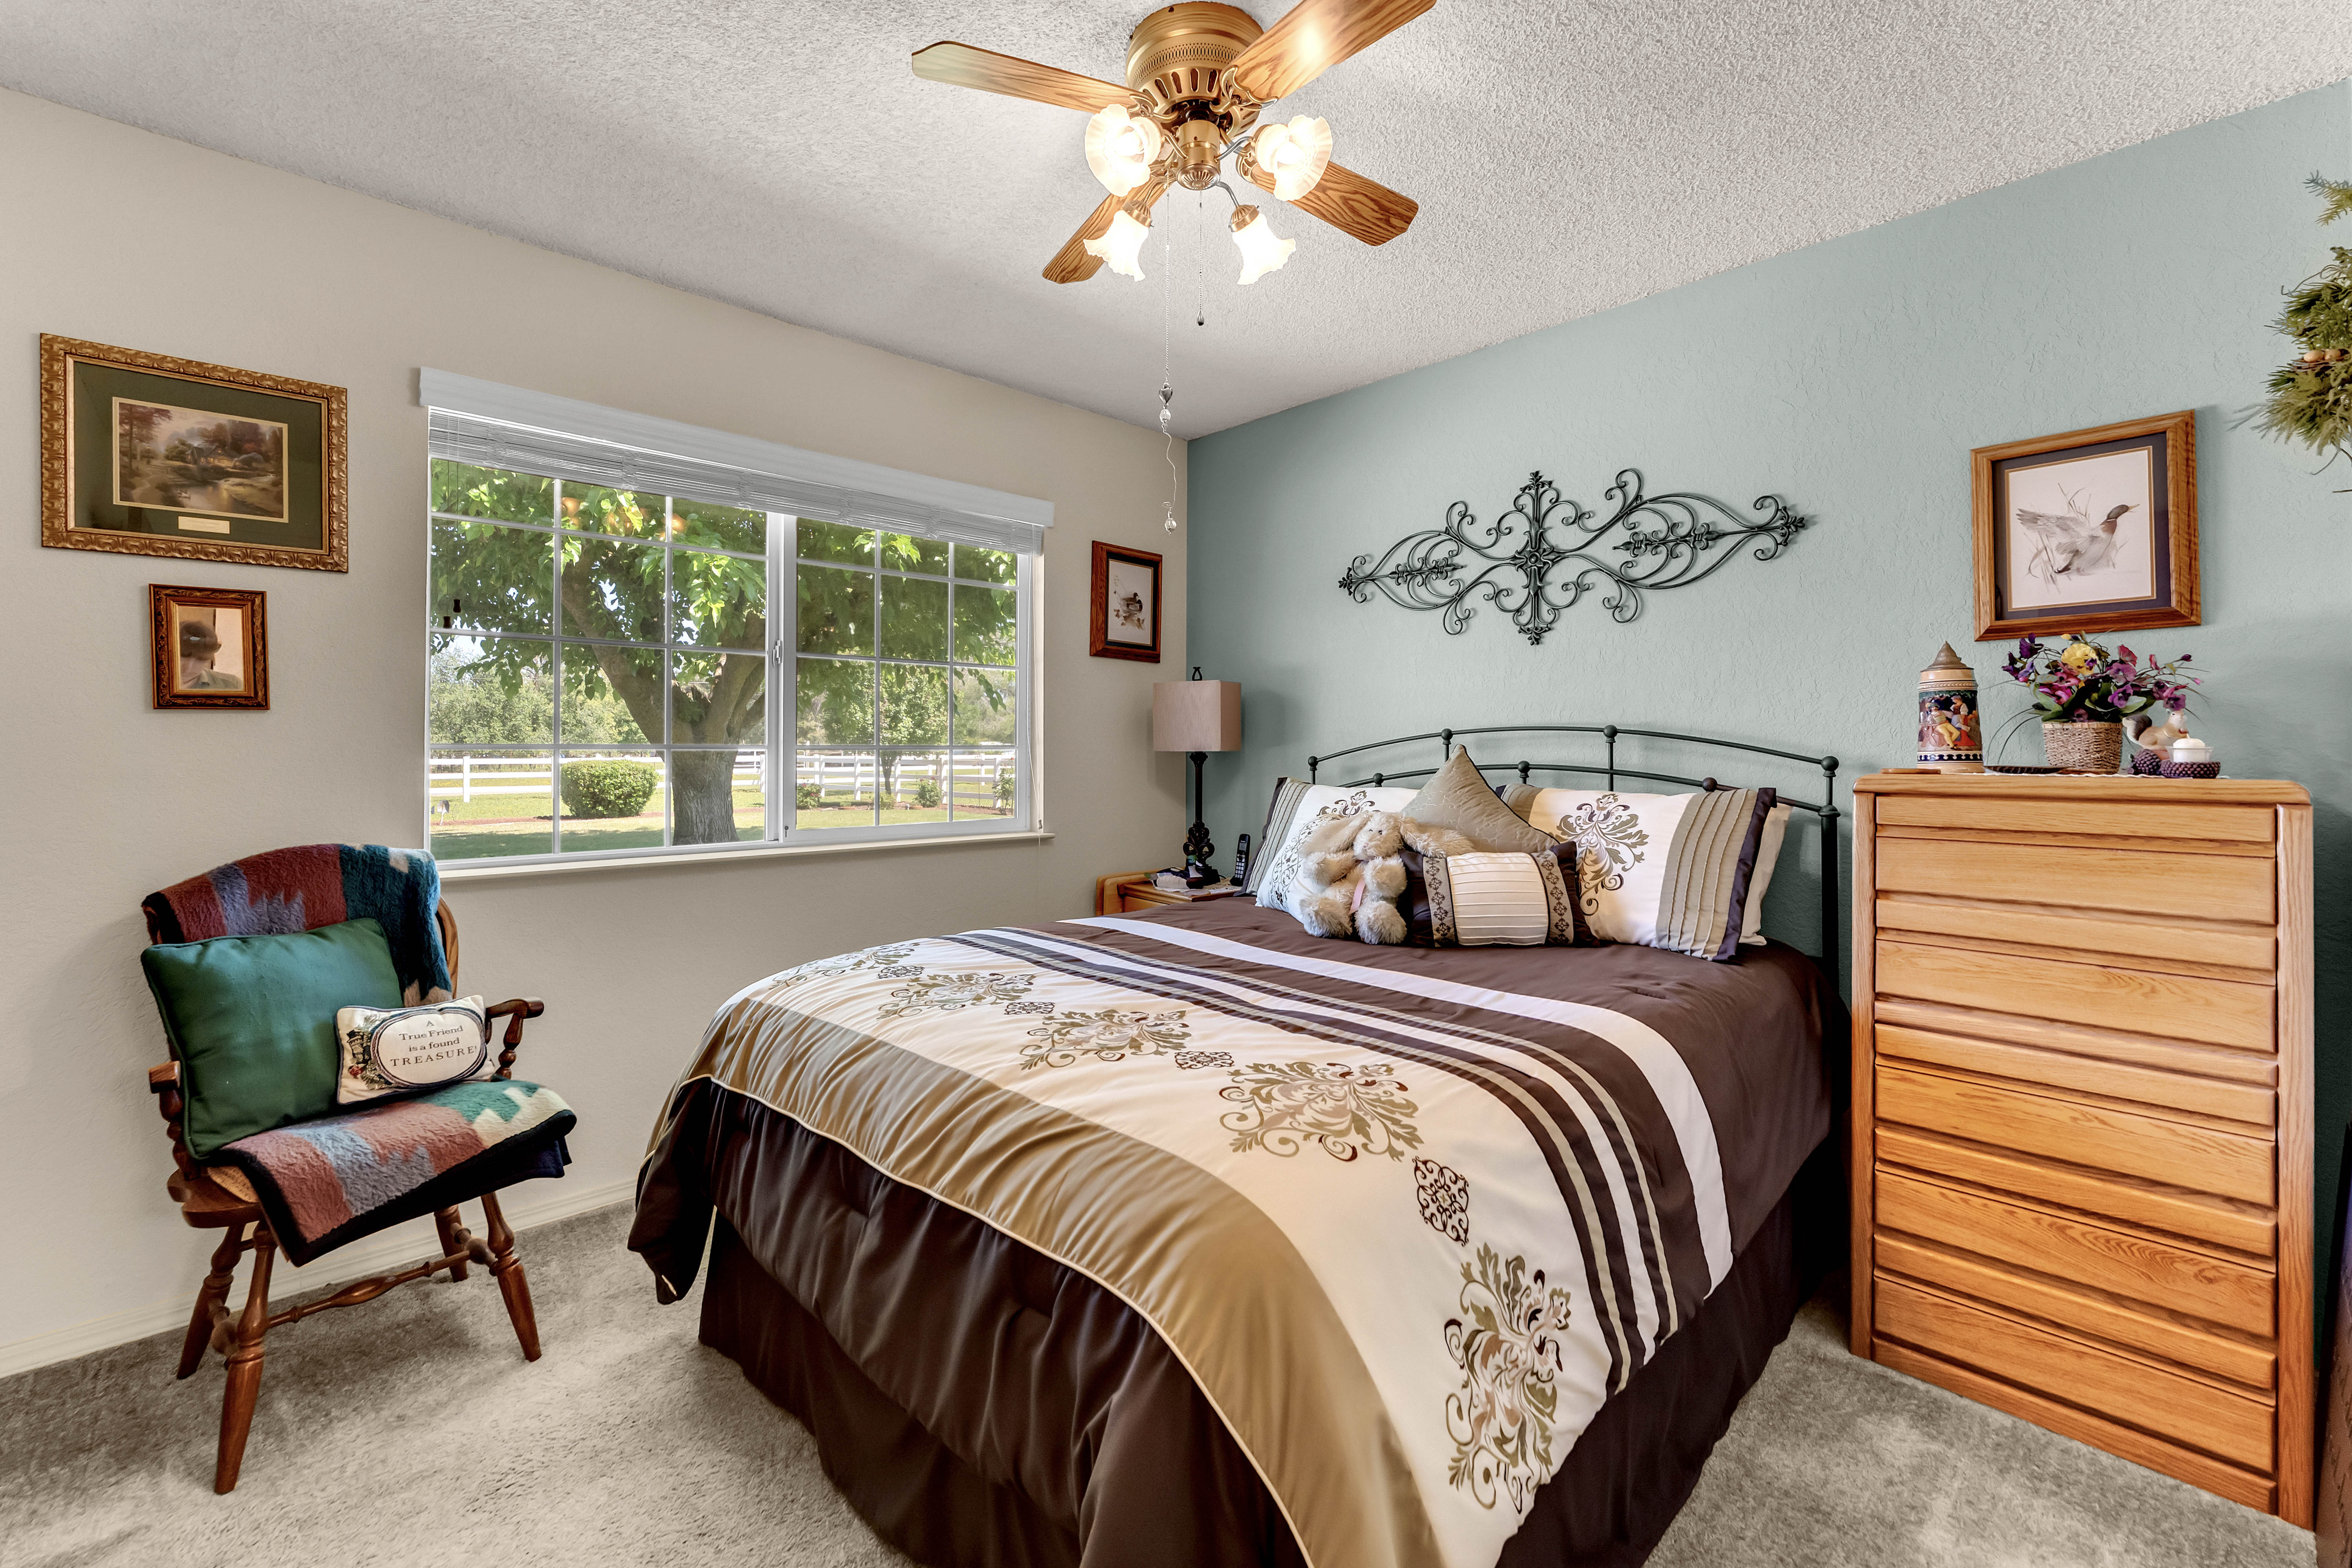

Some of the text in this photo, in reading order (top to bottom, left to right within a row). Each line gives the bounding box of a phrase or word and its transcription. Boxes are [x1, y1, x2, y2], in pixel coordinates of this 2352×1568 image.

[428, 1025, 463, 1037] Friend
[429, 1037, 460, 1049] found
[390, 1045, 477, 1067] TREASURE!
